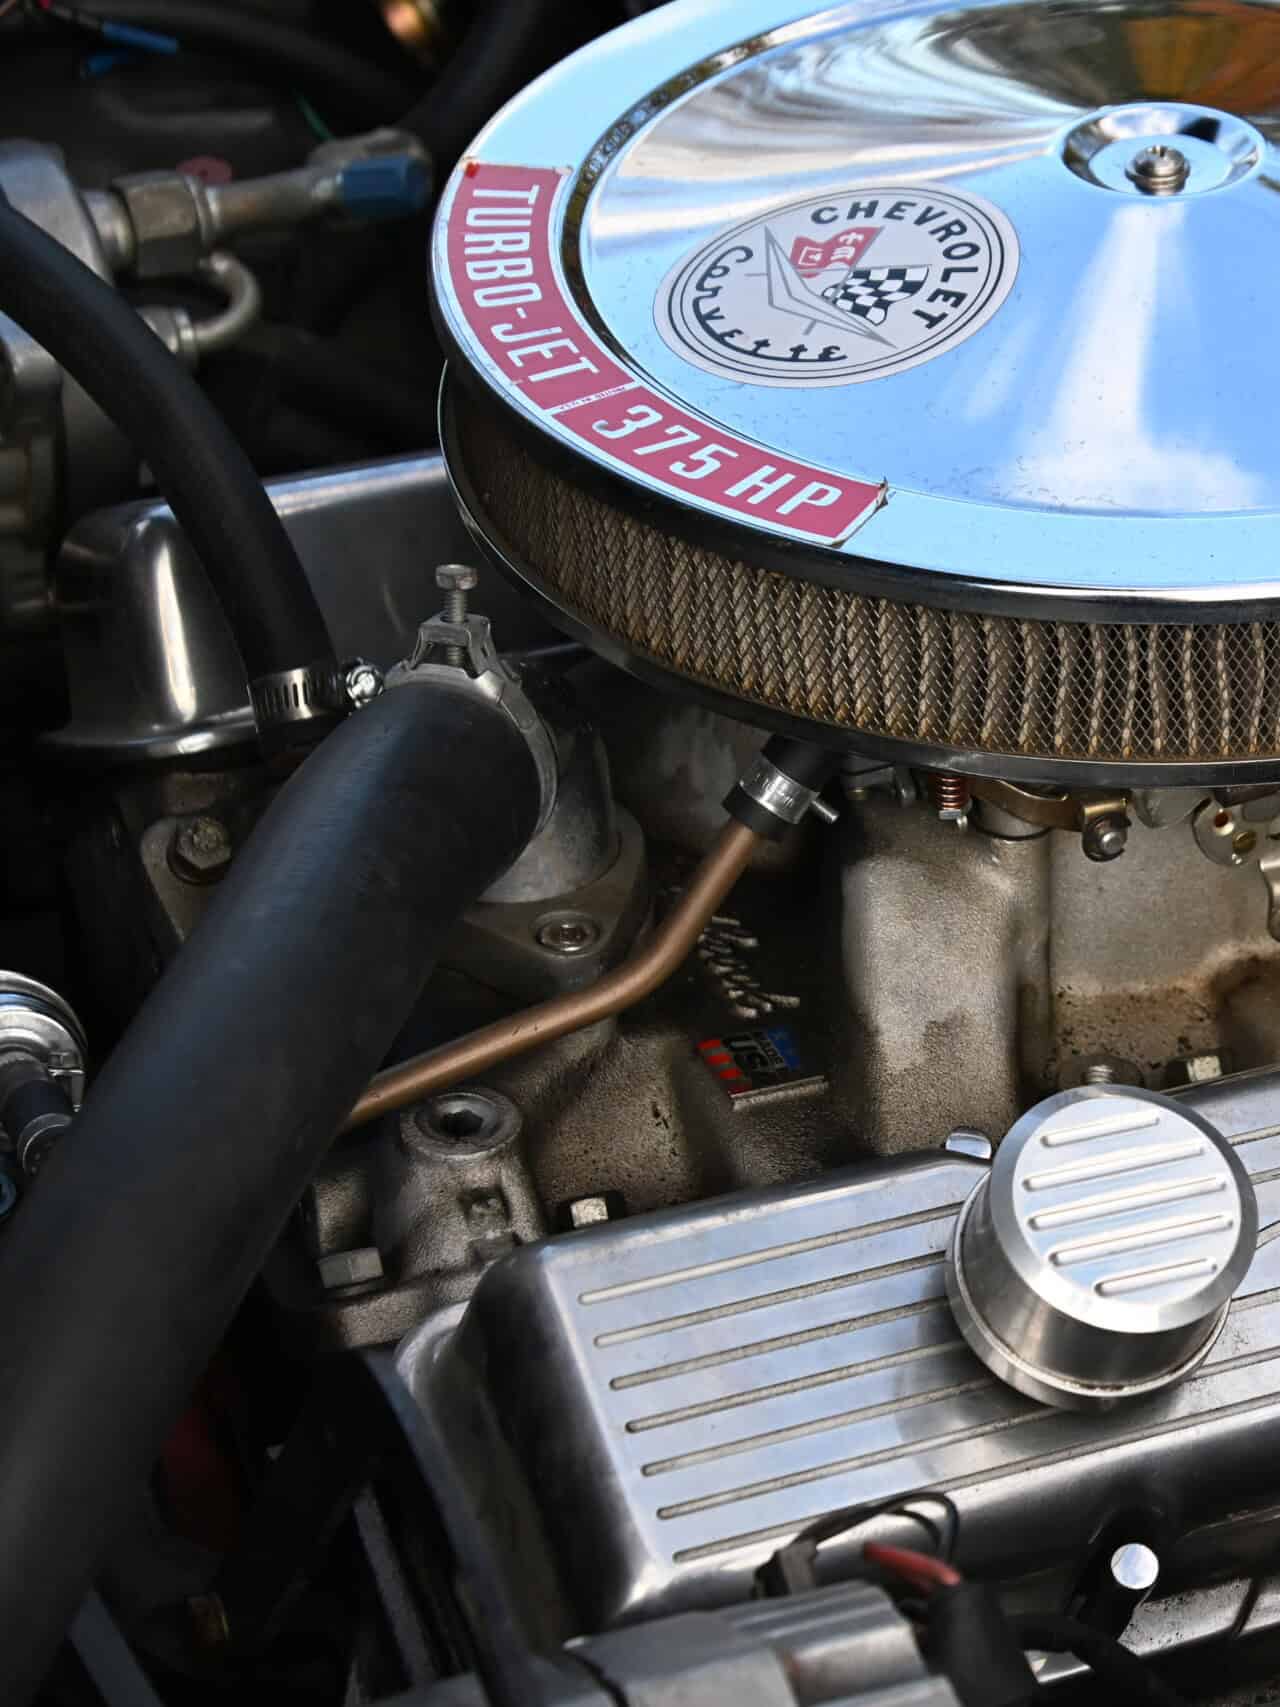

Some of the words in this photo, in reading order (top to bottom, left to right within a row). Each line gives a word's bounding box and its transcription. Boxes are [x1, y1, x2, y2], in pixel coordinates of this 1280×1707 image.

[464, 184, 600, 382] TURBO-JET
[811, 199, 980, 329] CHEVROLET
[591, 404, 740, 480] 375
[723, 464, 843, 516] HP
